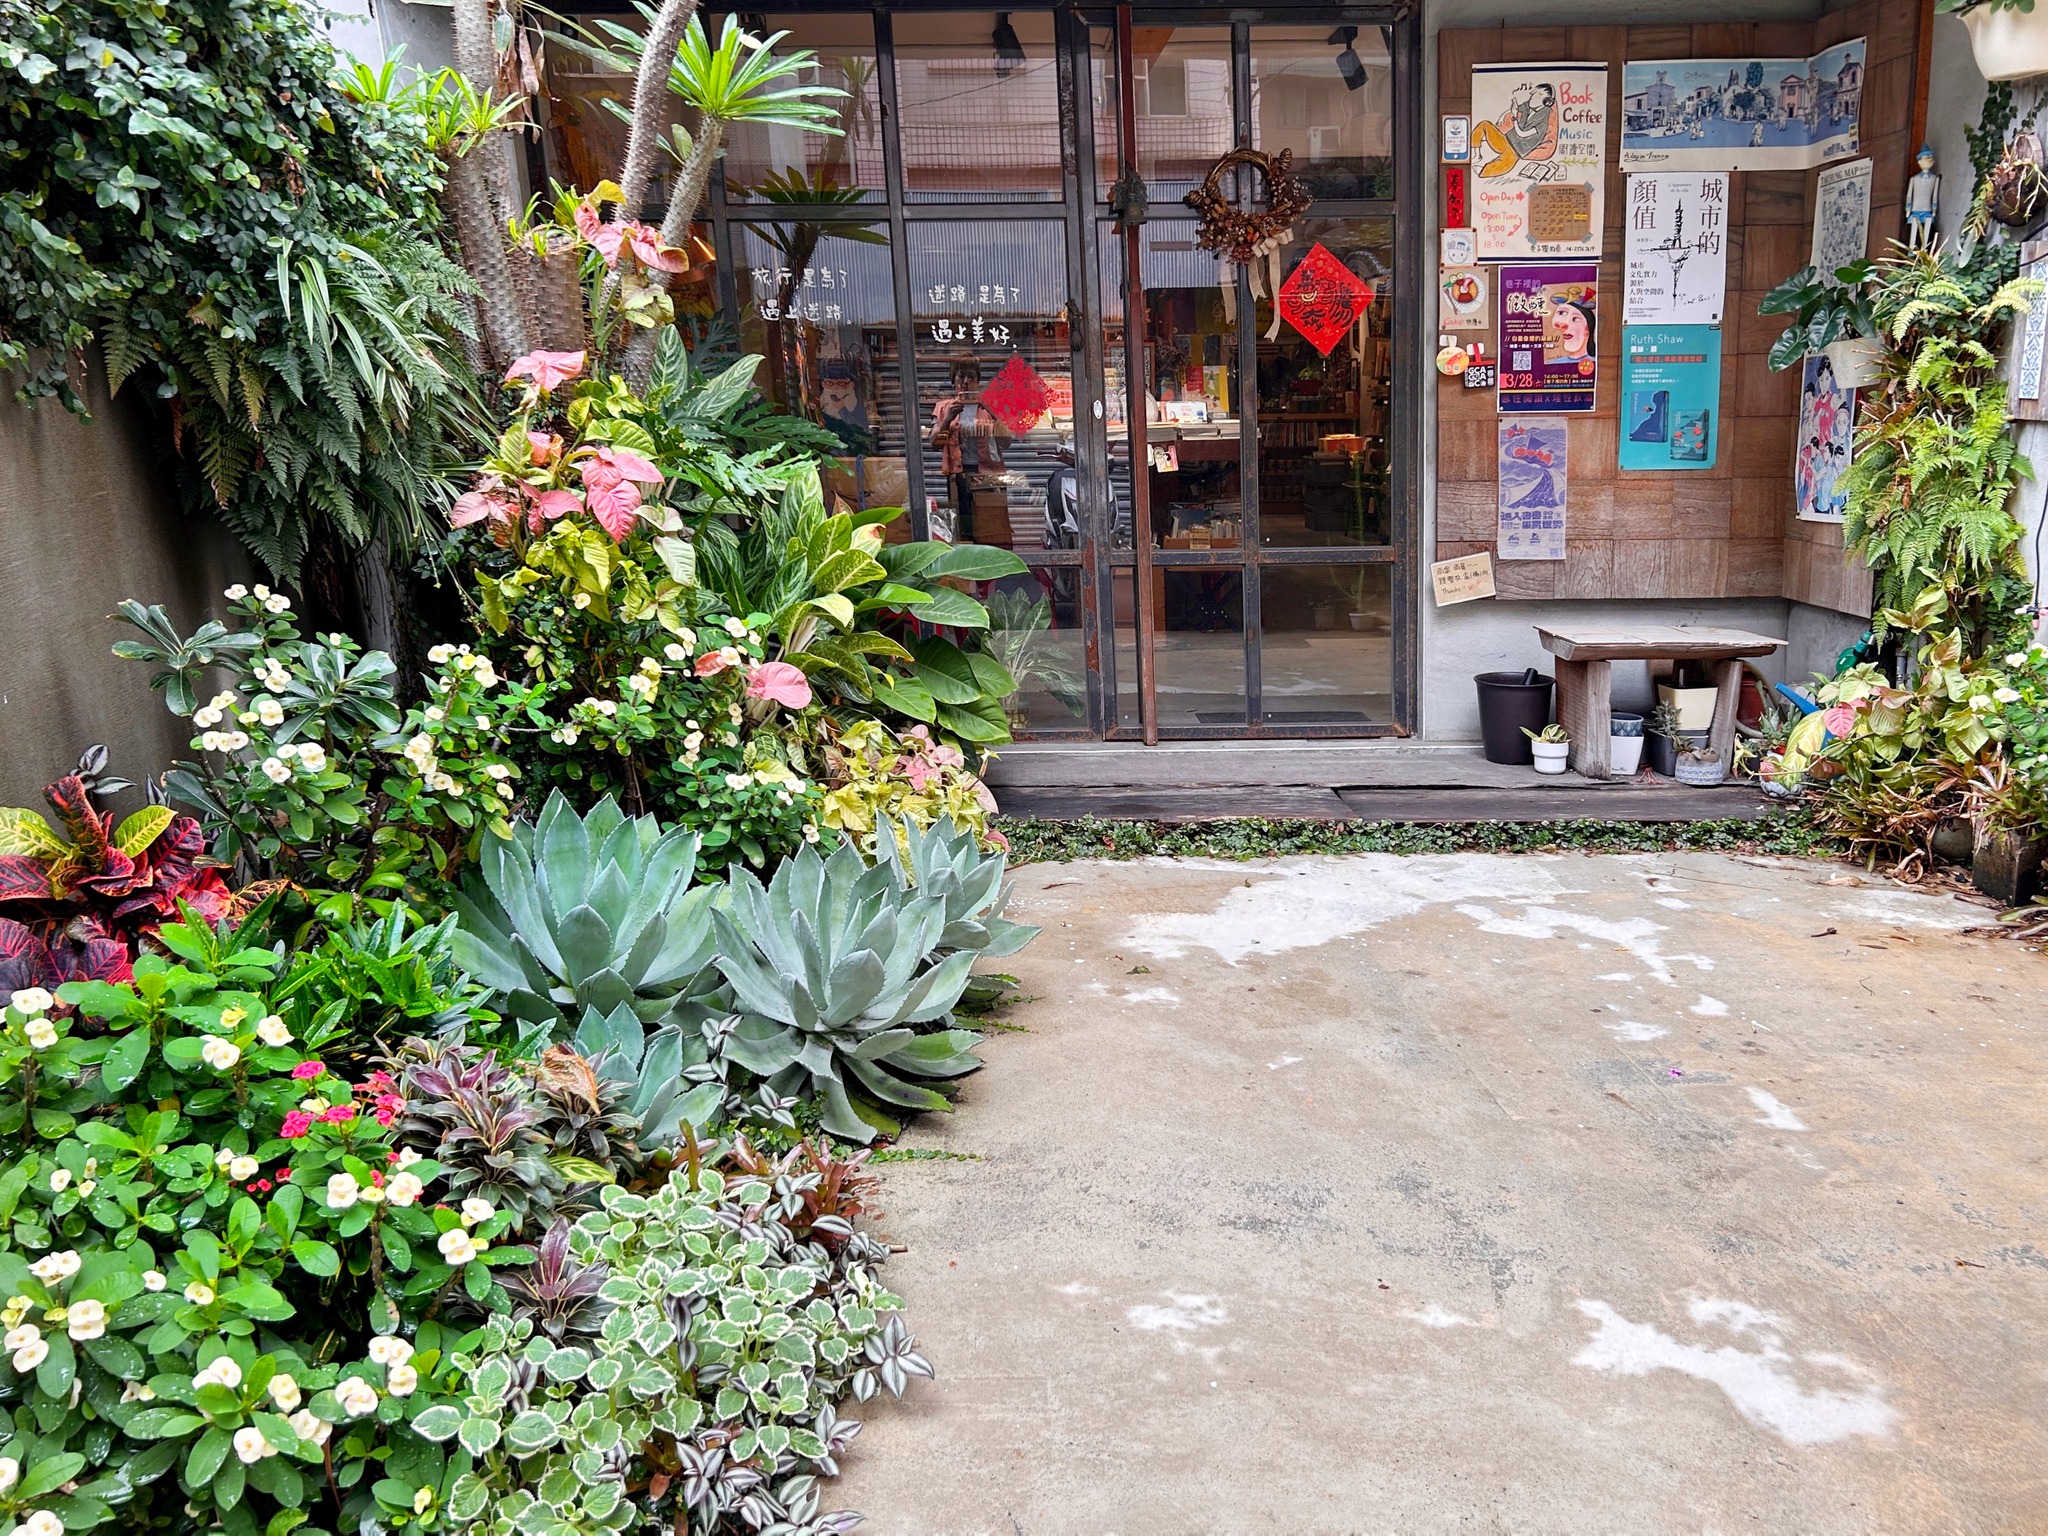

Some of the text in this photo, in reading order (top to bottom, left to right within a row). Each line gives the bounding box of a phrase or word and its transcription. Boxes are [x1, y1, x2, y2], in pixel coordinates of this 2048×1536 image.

[1559, 82, 1593, 105] Book
[1563, 107, 1602, 123] Coffee
[1559, 127, 1593, 139] Music
[1844, 166, 1859, 176] MAP
[1480, 192, 1515, 206] Open Day
[1632, 179, 1658, 231] 顏值
[1481, 211, 1519, 222] Open Time
[1698, 178, 1723, 255] 城市的
[1484, 225, 1505, 233] 13:00
[1630, 270, 1657, 278] 文化實力
[1629, 288, 1664, 296] 人與空間的
[1443, 317, 1464, 326] Cake
[1630, 334, 1684, 344] Ruth Shaw
[1506, 373, 1533, 388] 3/28
